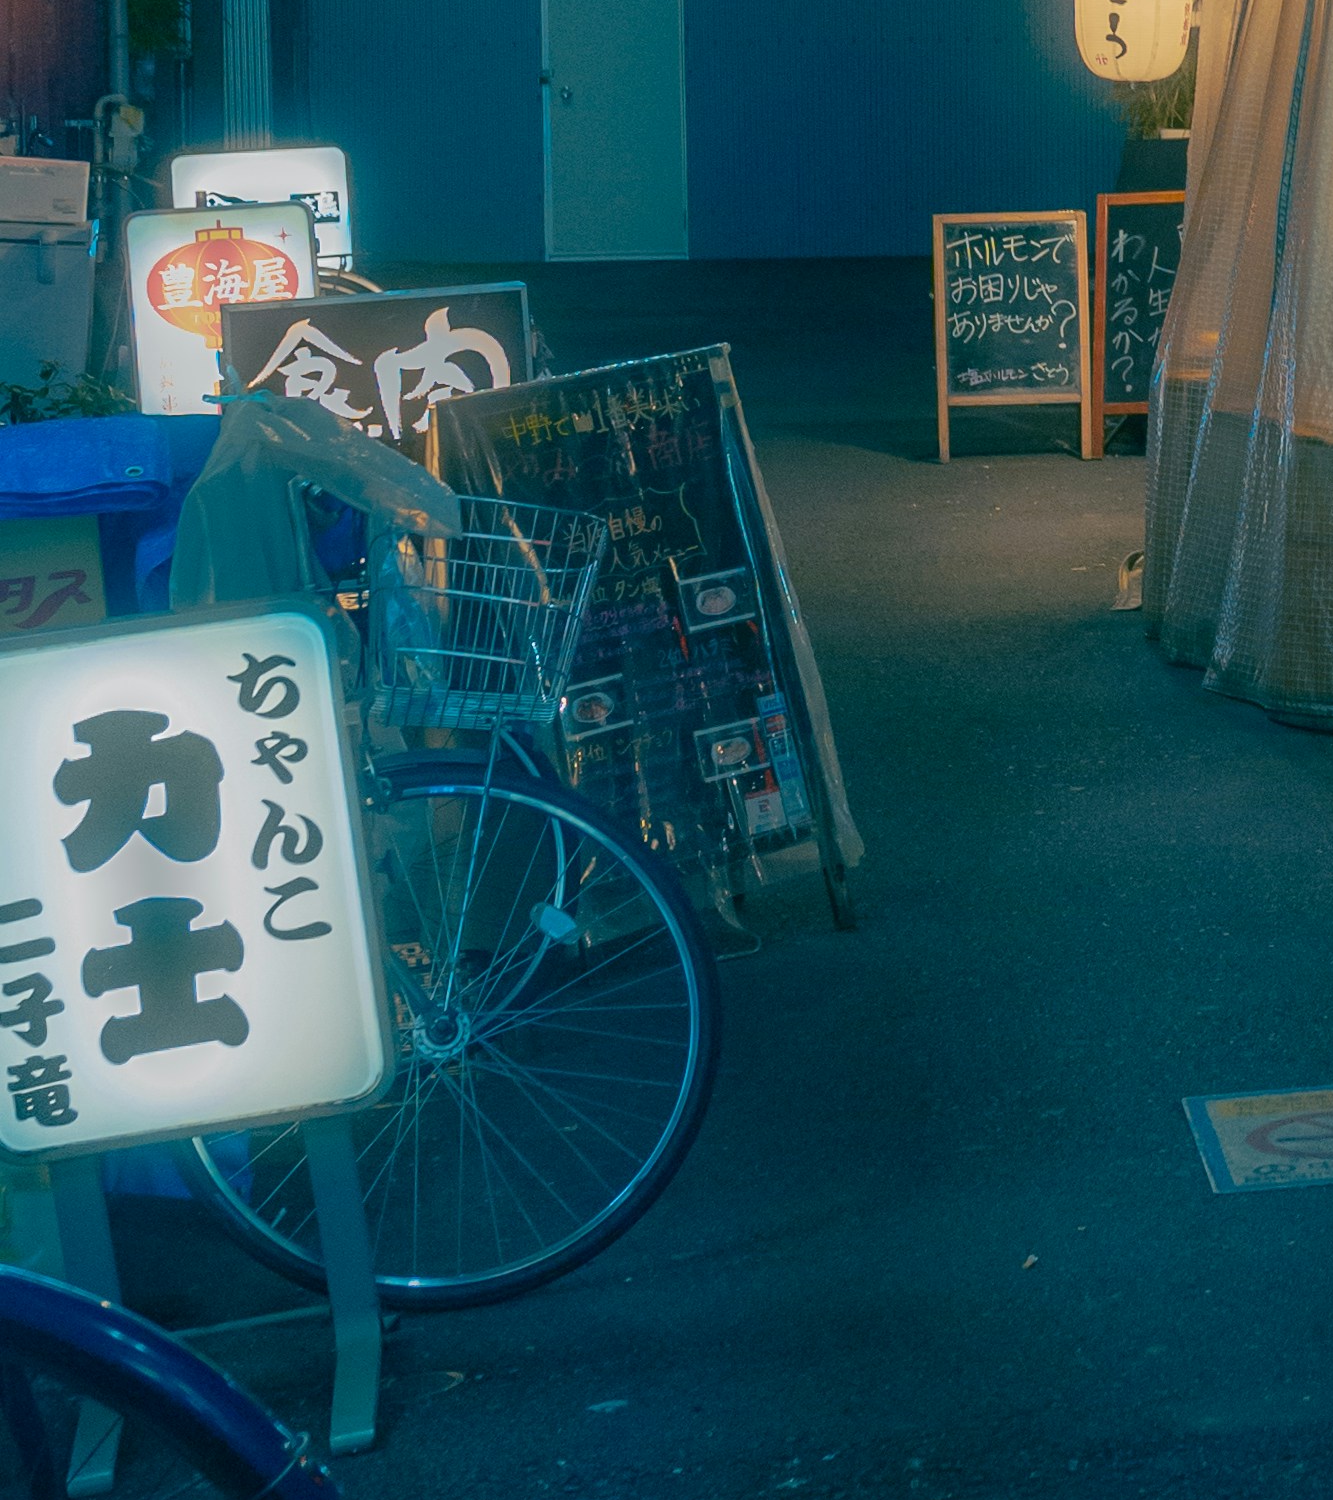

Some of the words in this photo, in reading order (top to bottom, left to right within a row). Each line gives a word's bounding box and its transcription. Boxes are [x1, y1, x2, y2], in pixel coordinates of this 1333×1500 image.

[157, 256, 293, 311] 豊海屋
[946, 231, 1073, 269] ホルモンで
[950, 273, 1058, 305] お困りじゃ
[948, 300, 1077, 349] ありませんか?
[1110, 229, 1146, 392] わかるか?
[247, 306, 511, 440] 食肉
[1031, 362, 1069, 385] さとう
[225, 649, 334, 945] ちゃんこ
[52, 708, 251, 1067] 力士
[0, 898, 81, 1129] 二子竜
